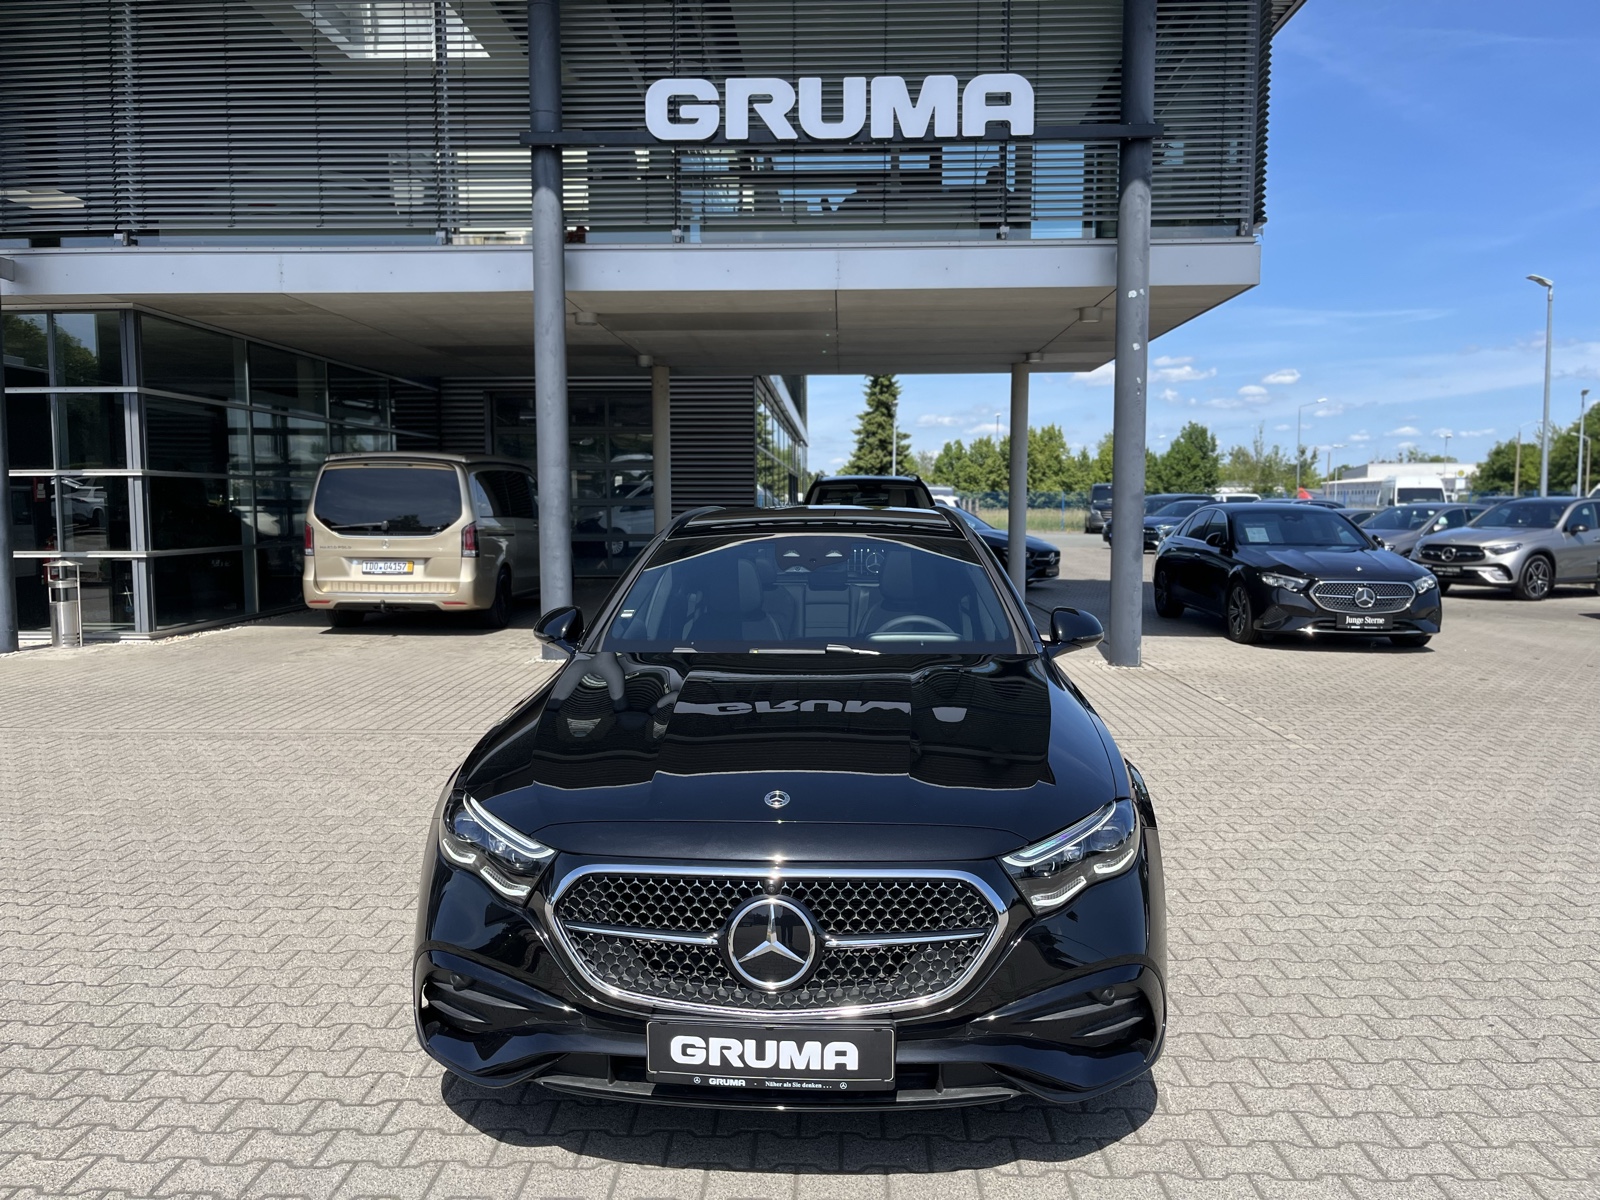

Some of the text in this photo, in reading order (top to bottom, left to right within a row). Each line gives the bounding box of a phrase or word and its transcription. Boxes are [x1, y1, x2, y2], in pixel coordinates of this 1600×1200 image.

[645, 73, 1035, 140] GRUMA
[1345, 615, 1385, 625] Junge Sterne
[670, 1035, 859, 1071] GRUMA
[708, 1077, 746, 1087] GRUMA
[765, 1080, 782, 1088] Näher
